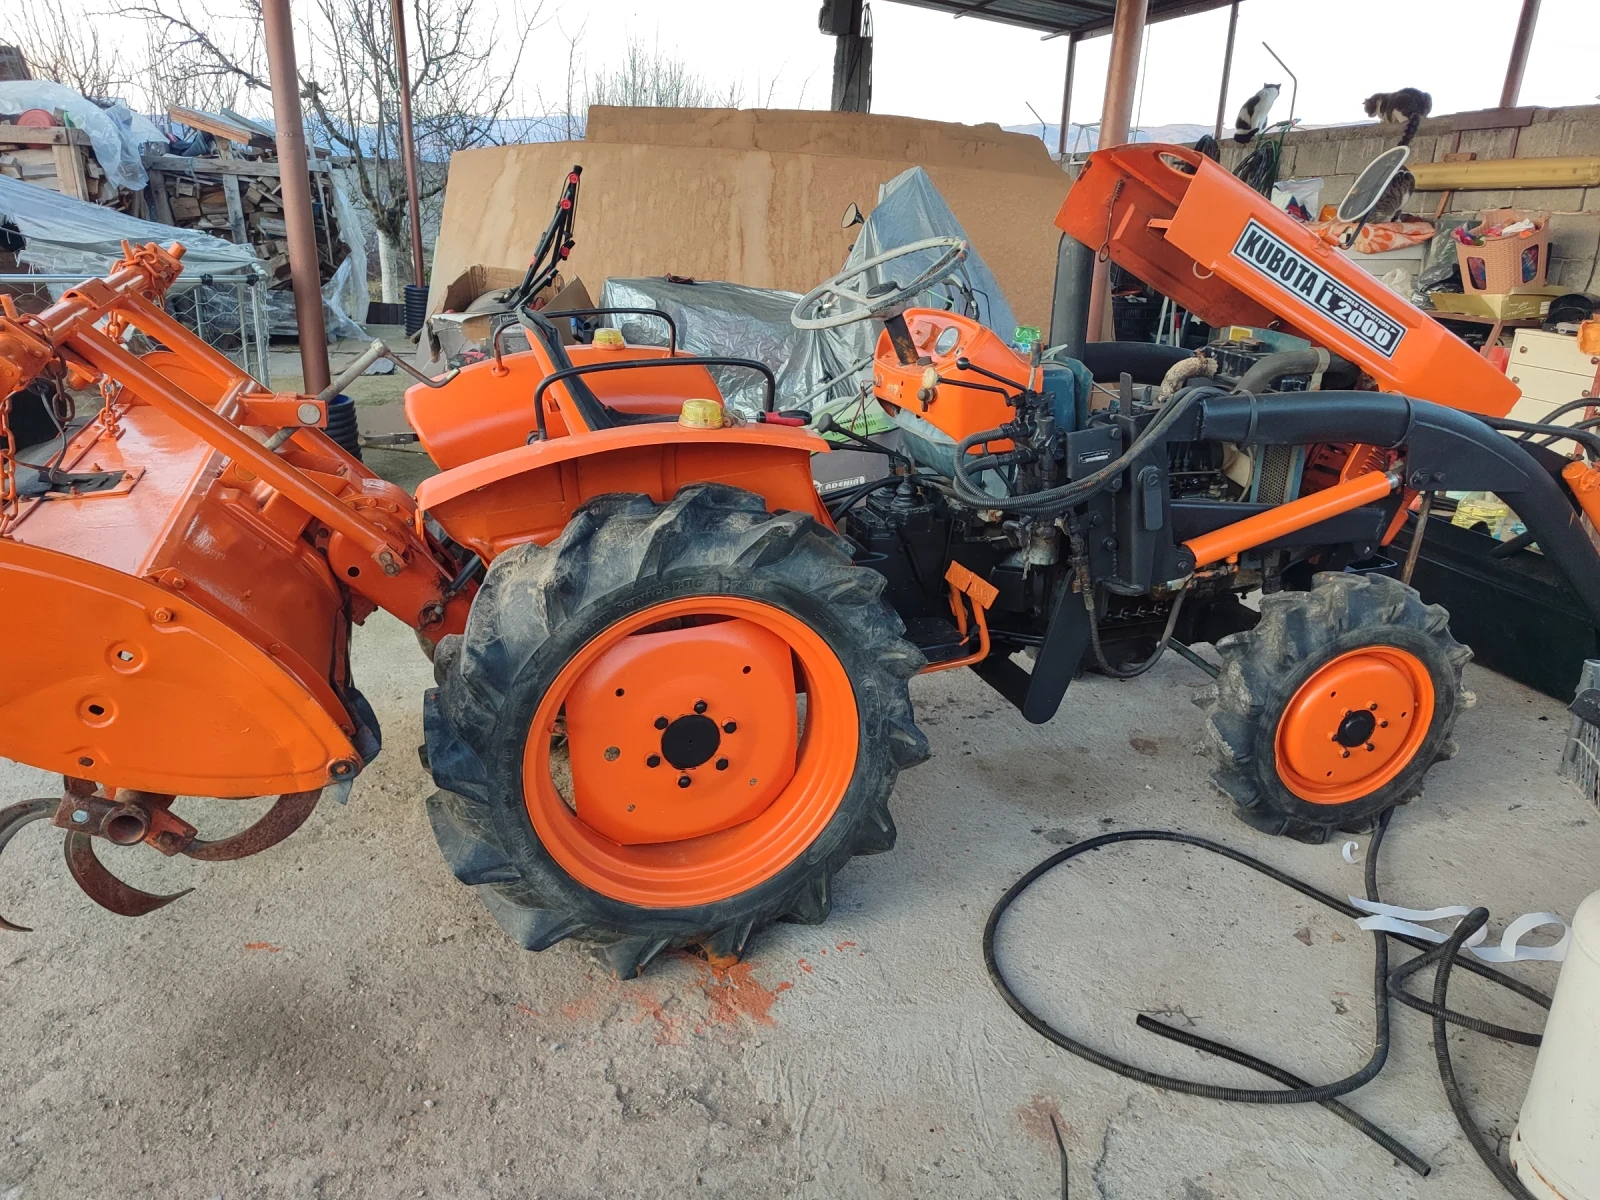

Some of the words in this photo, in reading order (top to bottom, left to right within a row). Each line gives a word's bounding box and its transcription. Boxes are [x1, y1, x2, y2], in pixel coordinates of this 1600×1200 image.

[1241, 229, 1318, 296] KUBOTA
[1319, 290, 1332, 308] L
[1333, 300, 1391, 345] 2000
[1332, 288, 1359, 308] DOUBLE
[1358, 305, 1392, 329] TRACTION
[614, 584, 669, 611] Service
